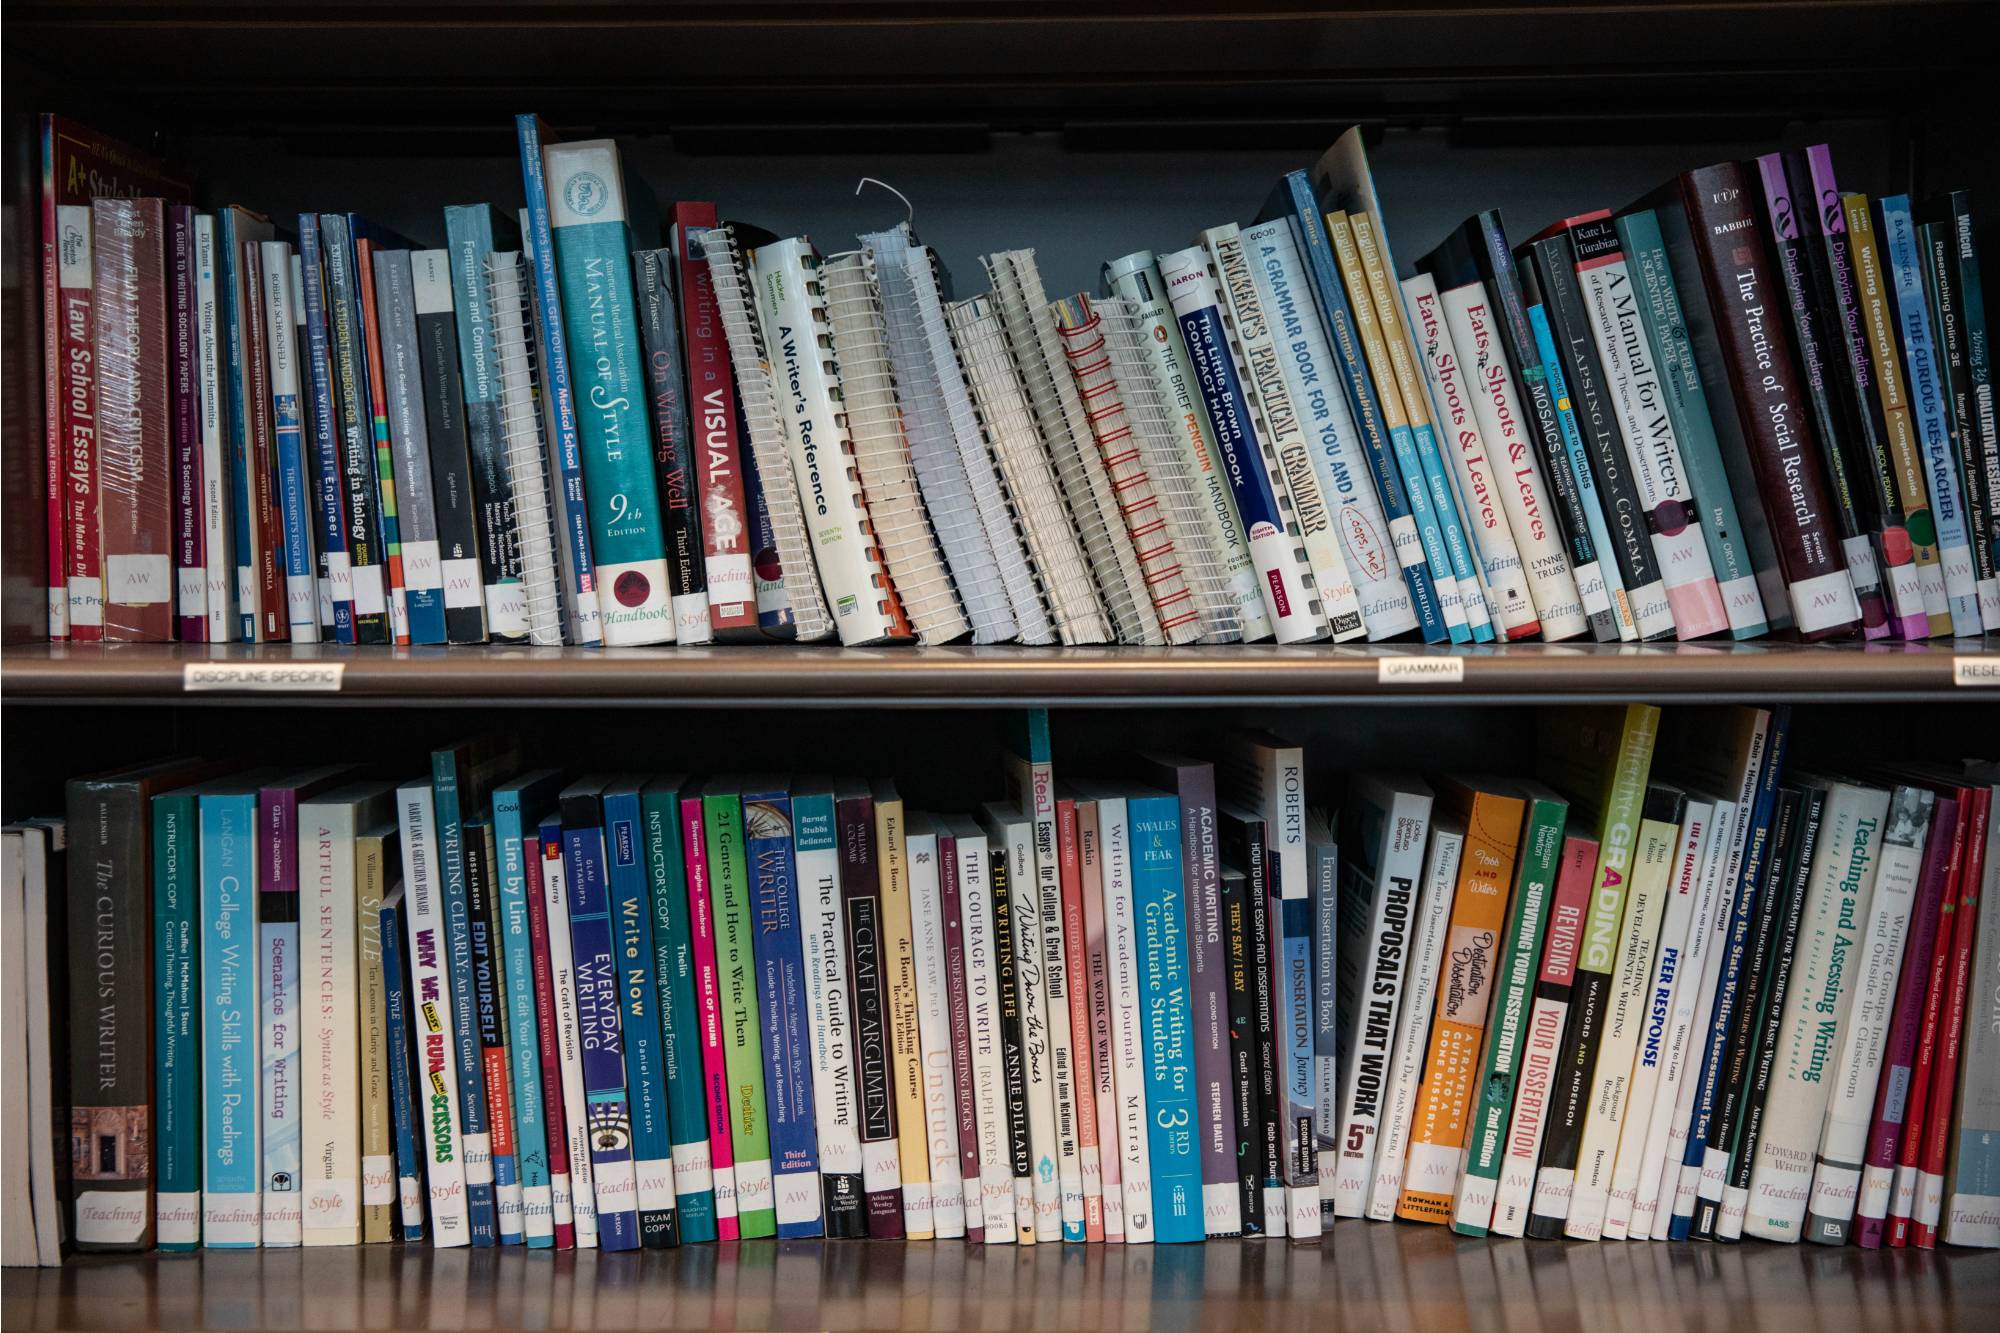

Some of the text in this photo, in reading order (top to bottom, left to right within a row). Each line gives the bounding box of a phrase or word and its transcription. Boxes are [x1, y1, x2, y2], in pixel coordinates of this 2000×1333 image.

[177, 231, 185, 257] GUIDE
[177, 260, 185, 270] TO
[1171, 270, 1204, 286] AARON
[1957, 214, 1972, 258] Wolcott
[69, 299, 91, 341] Law
[177, 274, 186, 309] WRITING
[463, 241, 489, 398] Feminism and Composition
[645, 255, 660, 330] William Zinsser
[766, 274, 779, 316] Sommers
[774, 270, 786, 302] Hacker
[1860, 246, 1900, 404] Writing Research Papers
[1935, 241, 1960, 367] Researching Online 3E
[178, 312, 187, 358] SOCIOLOGY
[180, 362, 188, 394] PAPERS
[203, 302, 216, 429] Writing About the Humanities
[584, 257, 630, 462] MANUAL OF STYLE
[70, 349, 93, 419] School
[779, 326, 828, 516] A Writer's Reference
[1186, 320, 1243, 487] COMPACT HANDBOOK
[1416, 294, 1500, 529] Eats, Shoots & Leaves
[1531, 384, 1561, 454] MOSAICS
[1606, 270, 1680, 498] A Manual for Writers
[1736, 268, 1815, 526] The Practice of Social Research
[71, 425, 93, 495] Essays
[652, 351, 689, 510] On Writing Well
[1161, 347, 1239, 549] THE BRIEF PENGUIN HANDBOOK
[75, 500, 85, 521] That
[287, 468, 301, 574] THE CHEMIST'S ENGLISH
[347, 426, 368, 540] Writing in Biology
[76, 524, 86, 551] Made
[1270, 574, 1288, 612] PEARSON
[1409, 564, 1434, 627] CAMBRIDGE
[193, 670, 334, 683] DISCIPLINE SPECIFIC
[1387, 663, 1459, 676] GRAMMAR
[1034, 771, 1051, 816] Real
[1284, 767, 1300, 844] ROBERTS
[504, 838, 524, 934] Line by Line
[1588, 822, 1632, 968] GRADING
[1679, 822, 1701, 894] LIU & HANSEN
[217, 876, 239, 939] College
[718, 812, 748, 1047] 21 Genres and How to Write Them
[965, 852, 991, 1055] THE COURAGE TO WRITE
[1801, 818, 1878, 1083] Teaching and Assessing Writing
[96, 860, 117, 1091] The CURIOUS WRITER
[216, 945, 240, 1005] Writing
[622, 898, 645, 1016] Write Now
[818, 876, 850, 1126] The Practical Guide to Writing
[1144, 902, 1167, 1081] Graduate Students
[1162, 888, 1188, 1092] Academic Writing for
[1354, 876, 1412, 1118] PROPOSALS THAT WORK
[221, 1010, 240, 1051] Skills
[271, 938, 286, 1119] Scenarios for Writing
[417, 929, 453, 1162] WHY WE MUST RUN WITH SCISSORS
[578, 962, 599, 1050] WRITING
[595, 954, 618, 1054] EVERYDAY
[855, 902, 886, 1132] THE CRAFT OF ARGUMENT
[994, 866, 1028, 1172] THE WRITING LIFE ANNIE DILLARD
[1512, 905, 1579, 1159] REVISING YOUR DISSERTATION
[1642, 948, 1678, 1068] PEER RESPONSE
[222, 1056, 240, 1087] with
[1565, 980, 1599, 1127] WALVOORD AND ANDERSON
[218, 1093, 240, 1165] Readings
[1127, 1096, 1140, 1164] Murray
[1211, 1082, 1223, 1153] STEPHEN BAILEY
[1479, 1107, 1501, 1167] 2nd Edition
[1881, 1137, 1894, 1162] KENT
